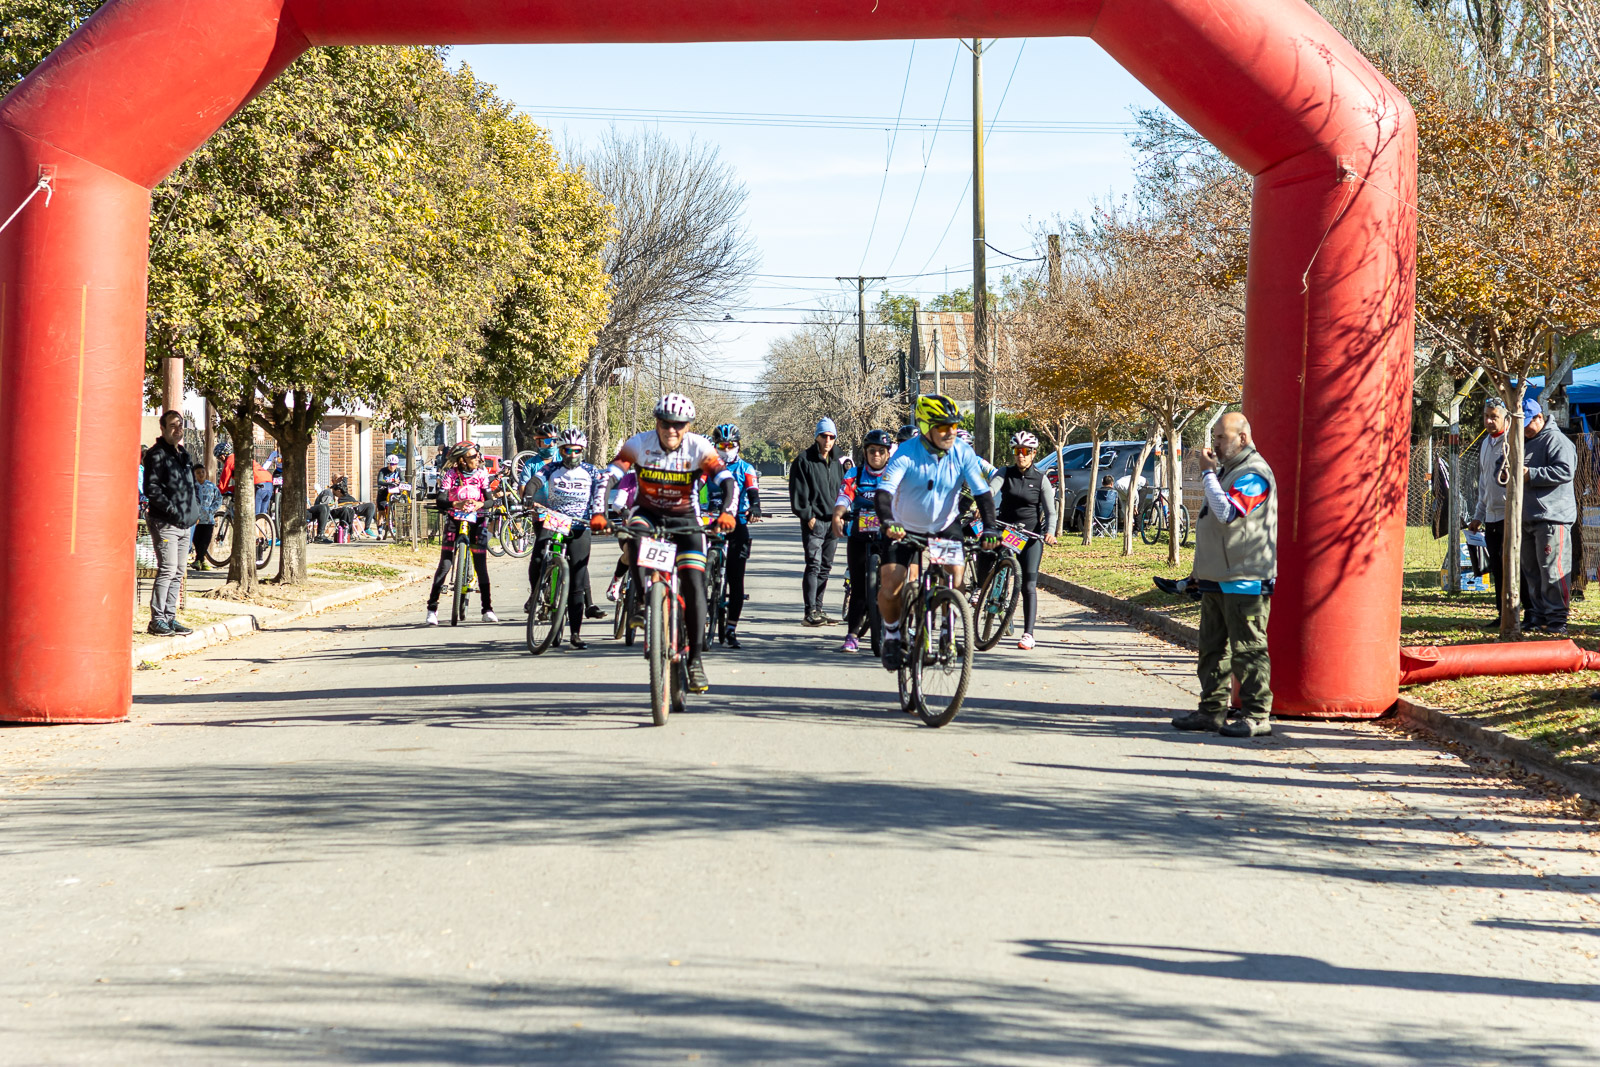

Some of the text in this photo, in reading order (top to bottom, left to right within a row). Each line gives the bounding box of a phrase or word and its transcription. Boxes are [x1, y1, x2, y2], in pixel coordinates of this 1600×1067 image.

[1005, 533, 1023, 547] 86
[645, 547, 669, 563] 85
[937, 546, 957, 558] 75
